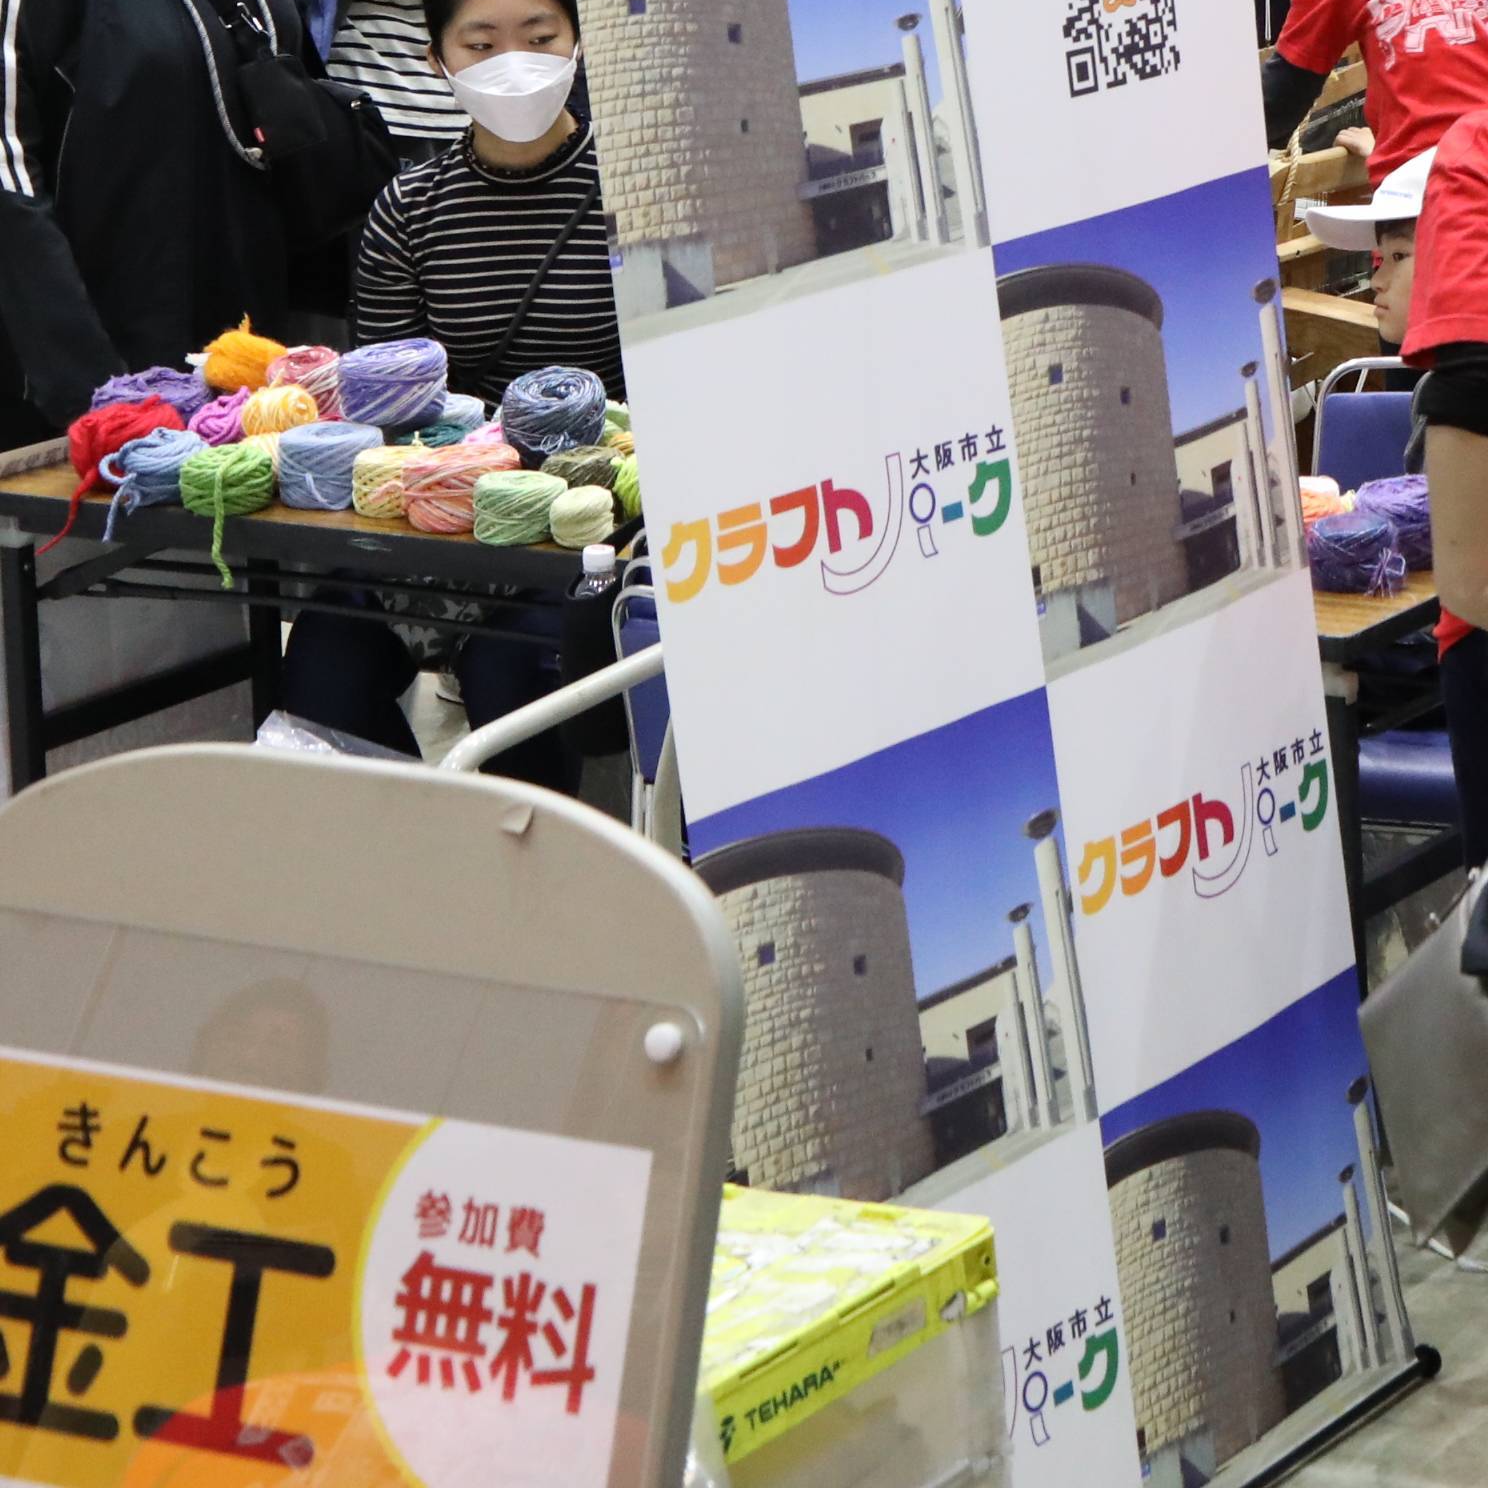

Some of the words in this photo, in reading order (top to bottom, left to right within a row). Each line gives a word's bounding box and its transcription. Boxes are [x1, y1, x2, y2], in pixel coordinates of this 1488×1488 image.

[910, 424, 1007, 480] 大阪市立
[1255, 728, 1324, 786] 大阪市立
[57, 1102, 301, 1199] きんこう
[413, 1190, 547, 1259] 参加費
[0, 1183, 337, 1469] 金工
[385, 1250, 599, 1416] 無料
[1023, 1295, 1115, 1371] 大阪市立
